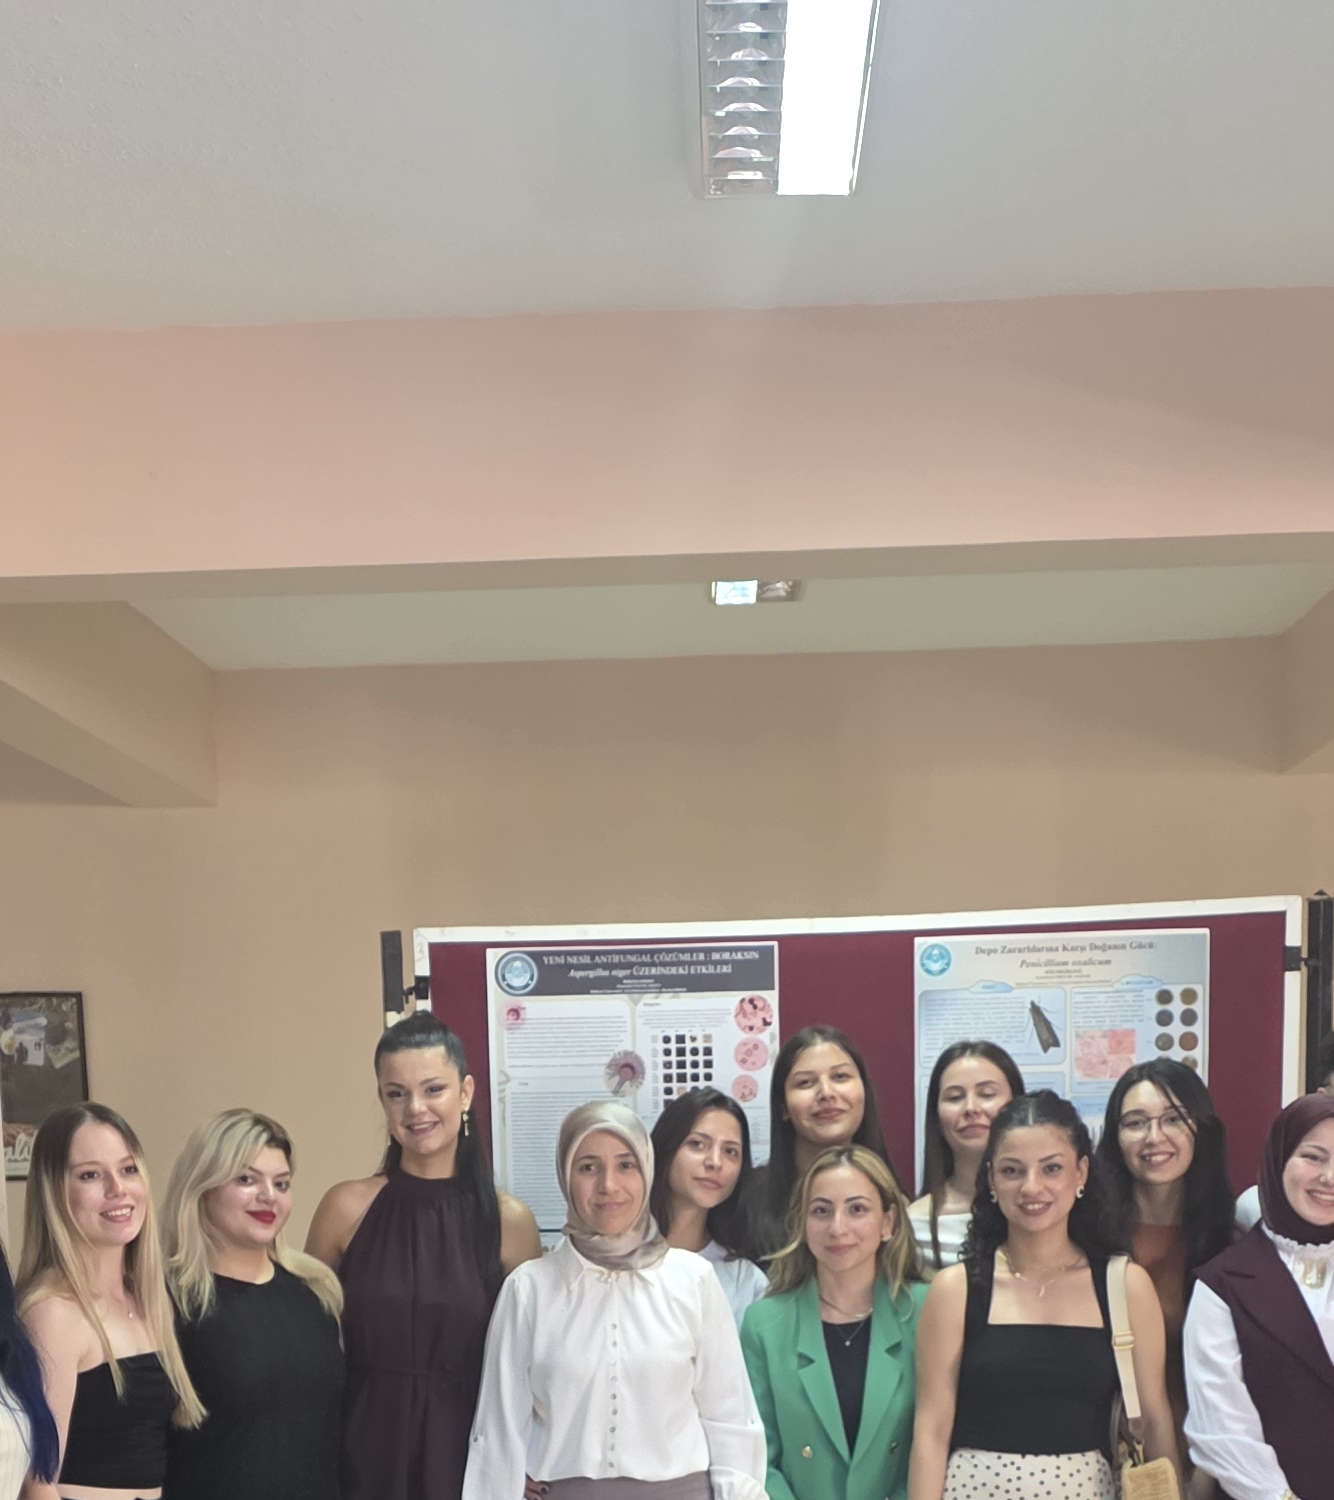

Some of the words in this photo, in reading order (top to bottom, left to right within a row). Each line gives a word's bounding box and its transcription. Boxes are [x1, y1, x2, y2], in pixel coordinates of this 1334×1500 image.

[975, 946, 998, 956] Depo
[543, 954, 565, 964] YENİ
[567, 954, 592, 964] NESİL
[593, 953, 651, 963] ANTİFUNGAL
[633, 964, 688, 975] ÜZERİNDEKİ
[690, 962, 732, 974] ETKİLERİ
